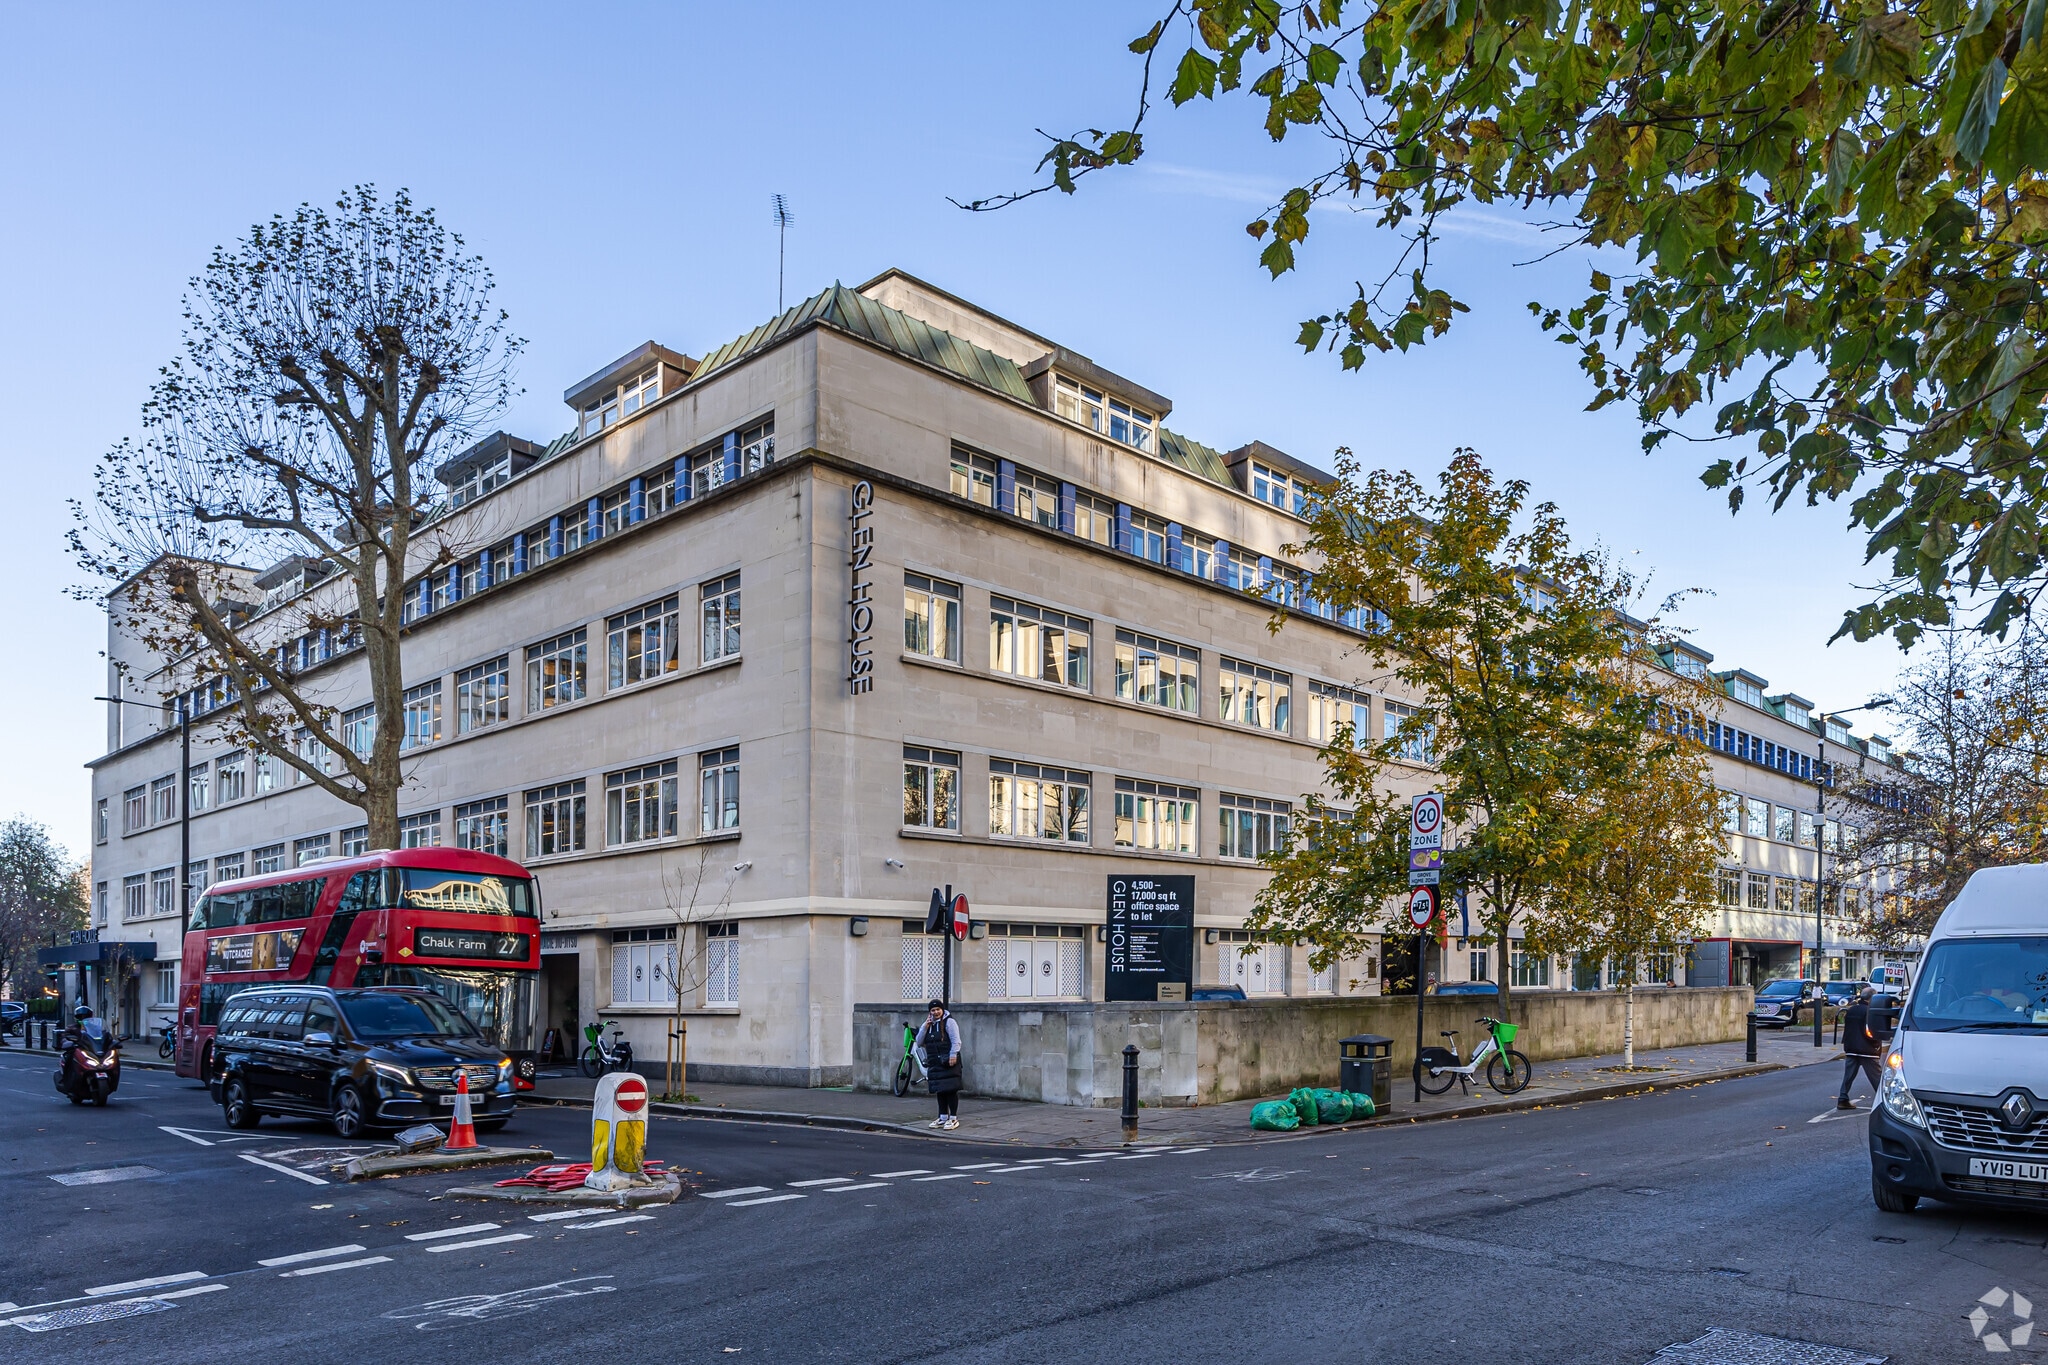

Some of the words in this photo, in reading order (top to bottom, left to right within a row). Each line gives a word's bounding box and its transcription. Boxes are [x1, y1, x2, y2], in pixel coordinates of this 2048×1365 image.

[853, 480, 873, 571] GLEN
[851, 581, 873, 695] HOUSE
[1418, 807, 1436, 823] 20
[1414, 834, 1438, 845] ZONE
[1131, 881, 1153, 890] 4,500
[1113, 880, 1126, 919] GLEN
[1131, 891, 1156, 900] 17,000
[1158, 893, 1168, 902] sq
[1170, 891, 1177, 900] ft
[1131, 902, 1154, 910] office
[1155, 903, 1179, 912] space
[1131, 913, 1139, 921] to
[1141, 912, 1152, 921] let
[420, 935, 454, 949] Chalk
[458, 938, 486, 950] Farm
[498, 937, 519, 954] 27
[1111, 924, 1125, 972] HOUSE
[1980, 1160, 2014, 1177] YV19
[2018, 1164, 2048, 1180] LUT
